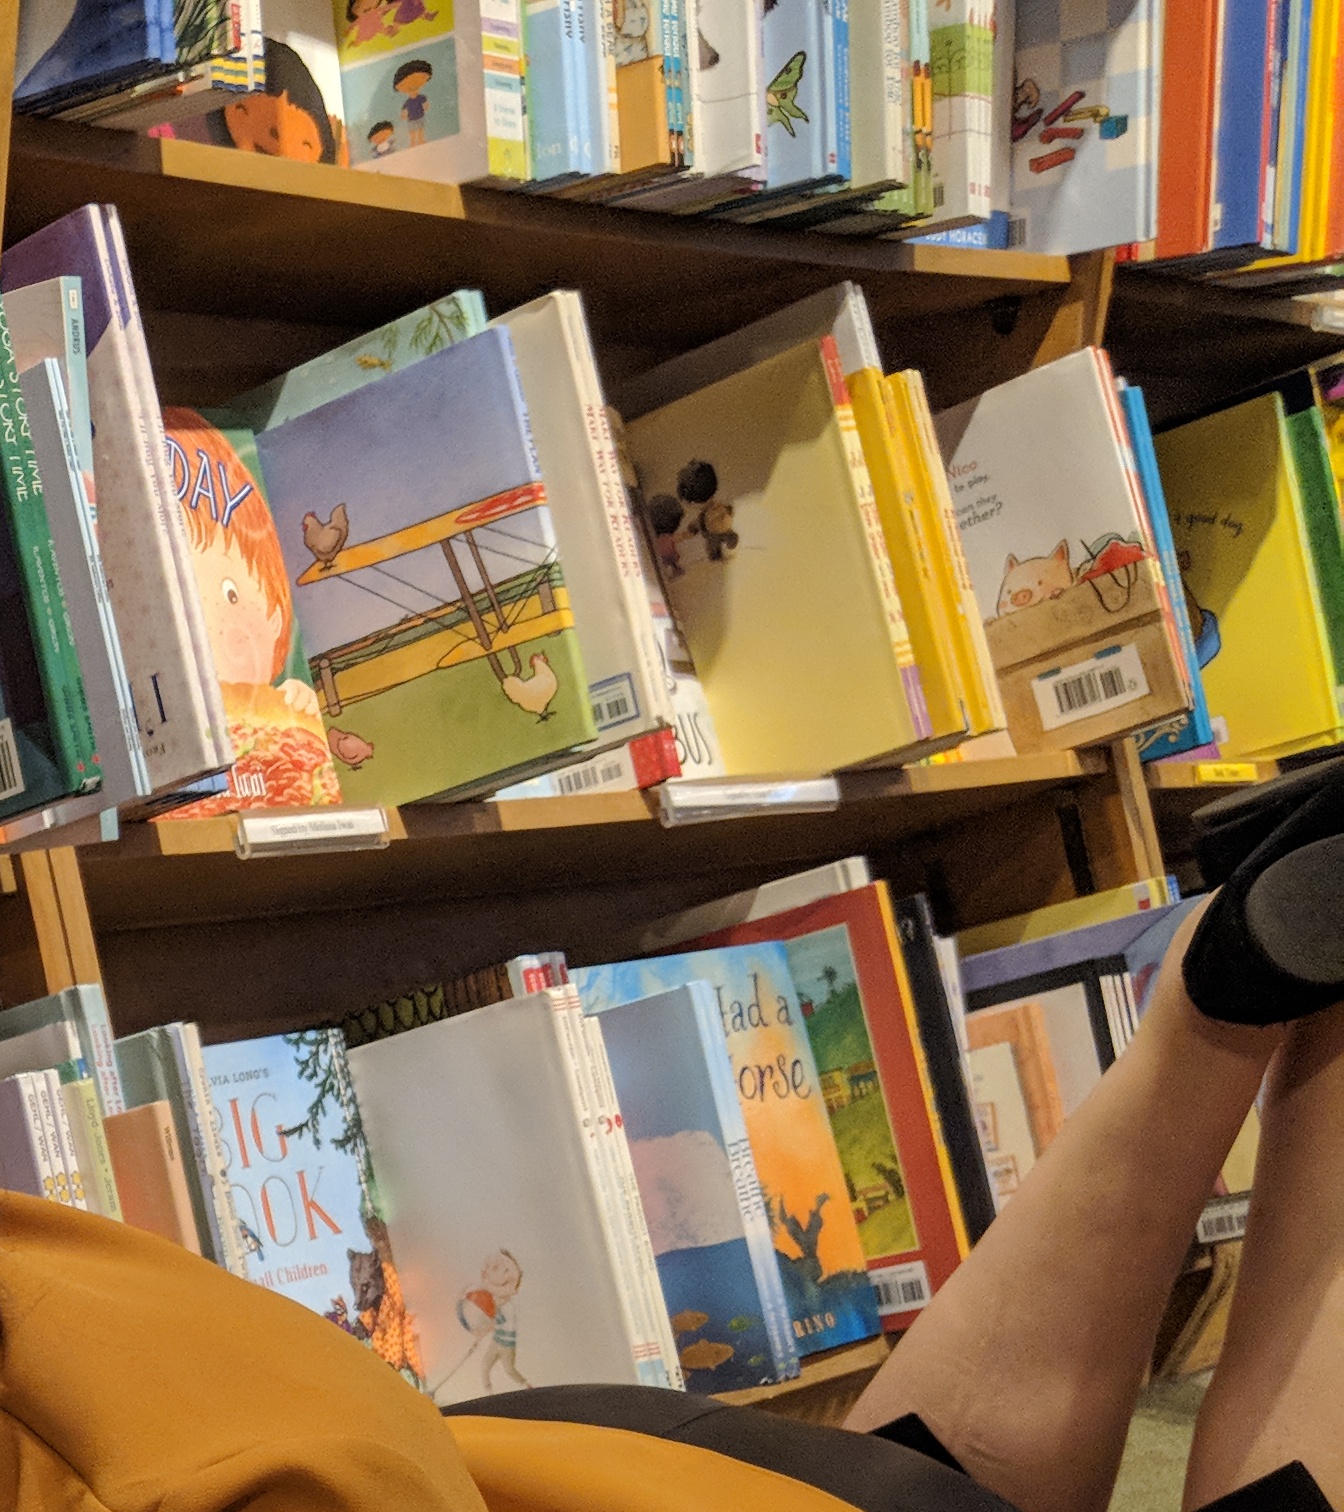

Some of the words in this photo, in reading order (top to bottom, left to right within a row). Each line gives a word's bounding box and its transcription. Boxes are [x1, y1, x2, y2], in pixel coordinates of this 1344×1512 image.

[164, 434, 253, 527] DAY
[777, 994, 794, 1026] a
[237, 1067, 270, 1085] LONG'S
[738, 1055, 811, 1101] orse
[277, 1263, 328, 1284] Children
